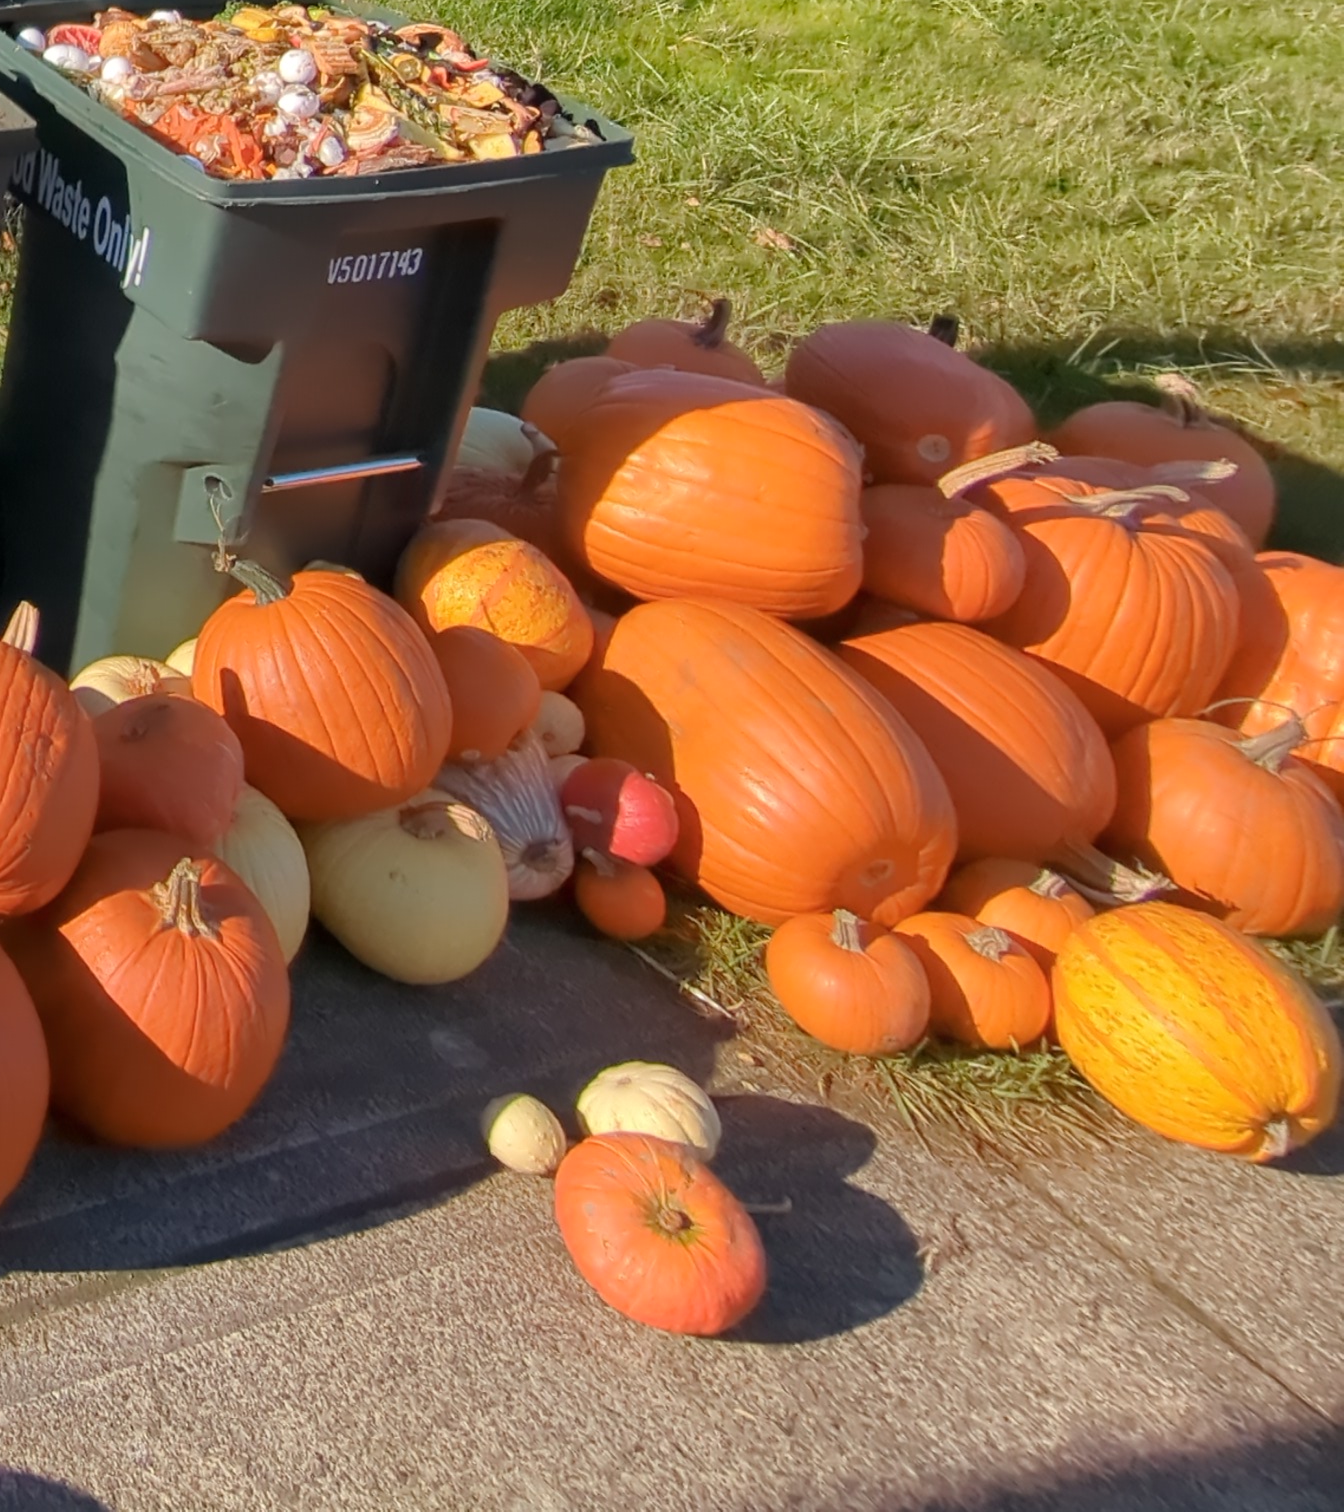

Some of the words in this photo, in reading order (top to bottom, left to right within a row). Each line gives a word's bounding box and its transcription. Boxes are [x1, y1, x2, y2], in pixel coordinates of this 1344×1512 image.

[37, 148, 90, 241] Waste
[93, 196, 150, 289] Only!
[327, 248, 423, 284] V5017143
